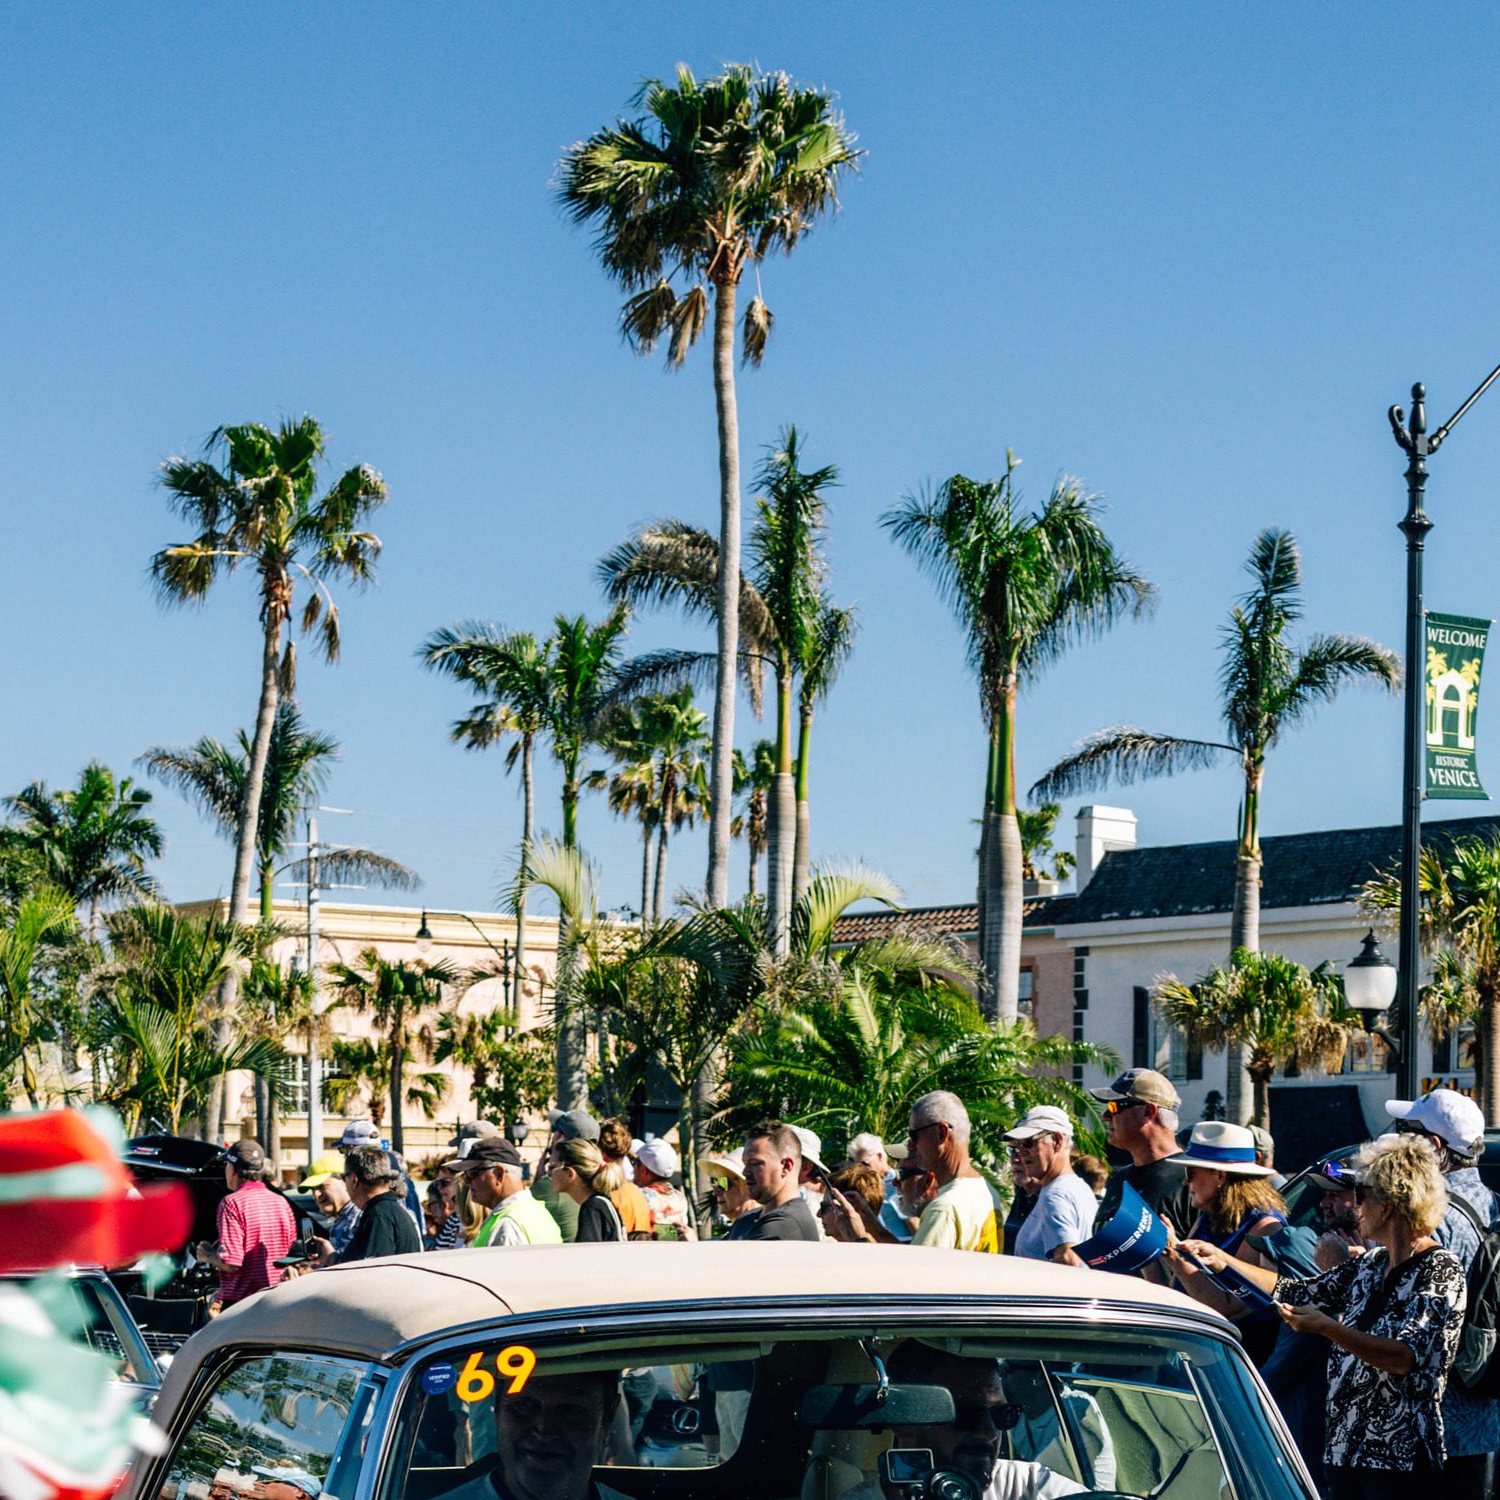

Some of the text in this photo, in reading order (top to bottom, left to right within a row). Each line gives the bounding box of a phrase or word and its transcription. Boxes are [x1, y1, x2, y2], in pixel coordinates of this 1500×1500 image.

[1427, 626, 1486, 649] WELCOME
[1436, 755, 1469, 769] HISTORIC
[1428, 767, 1480, 788] VENICE
[456, 1345, 537, 1403] 69
